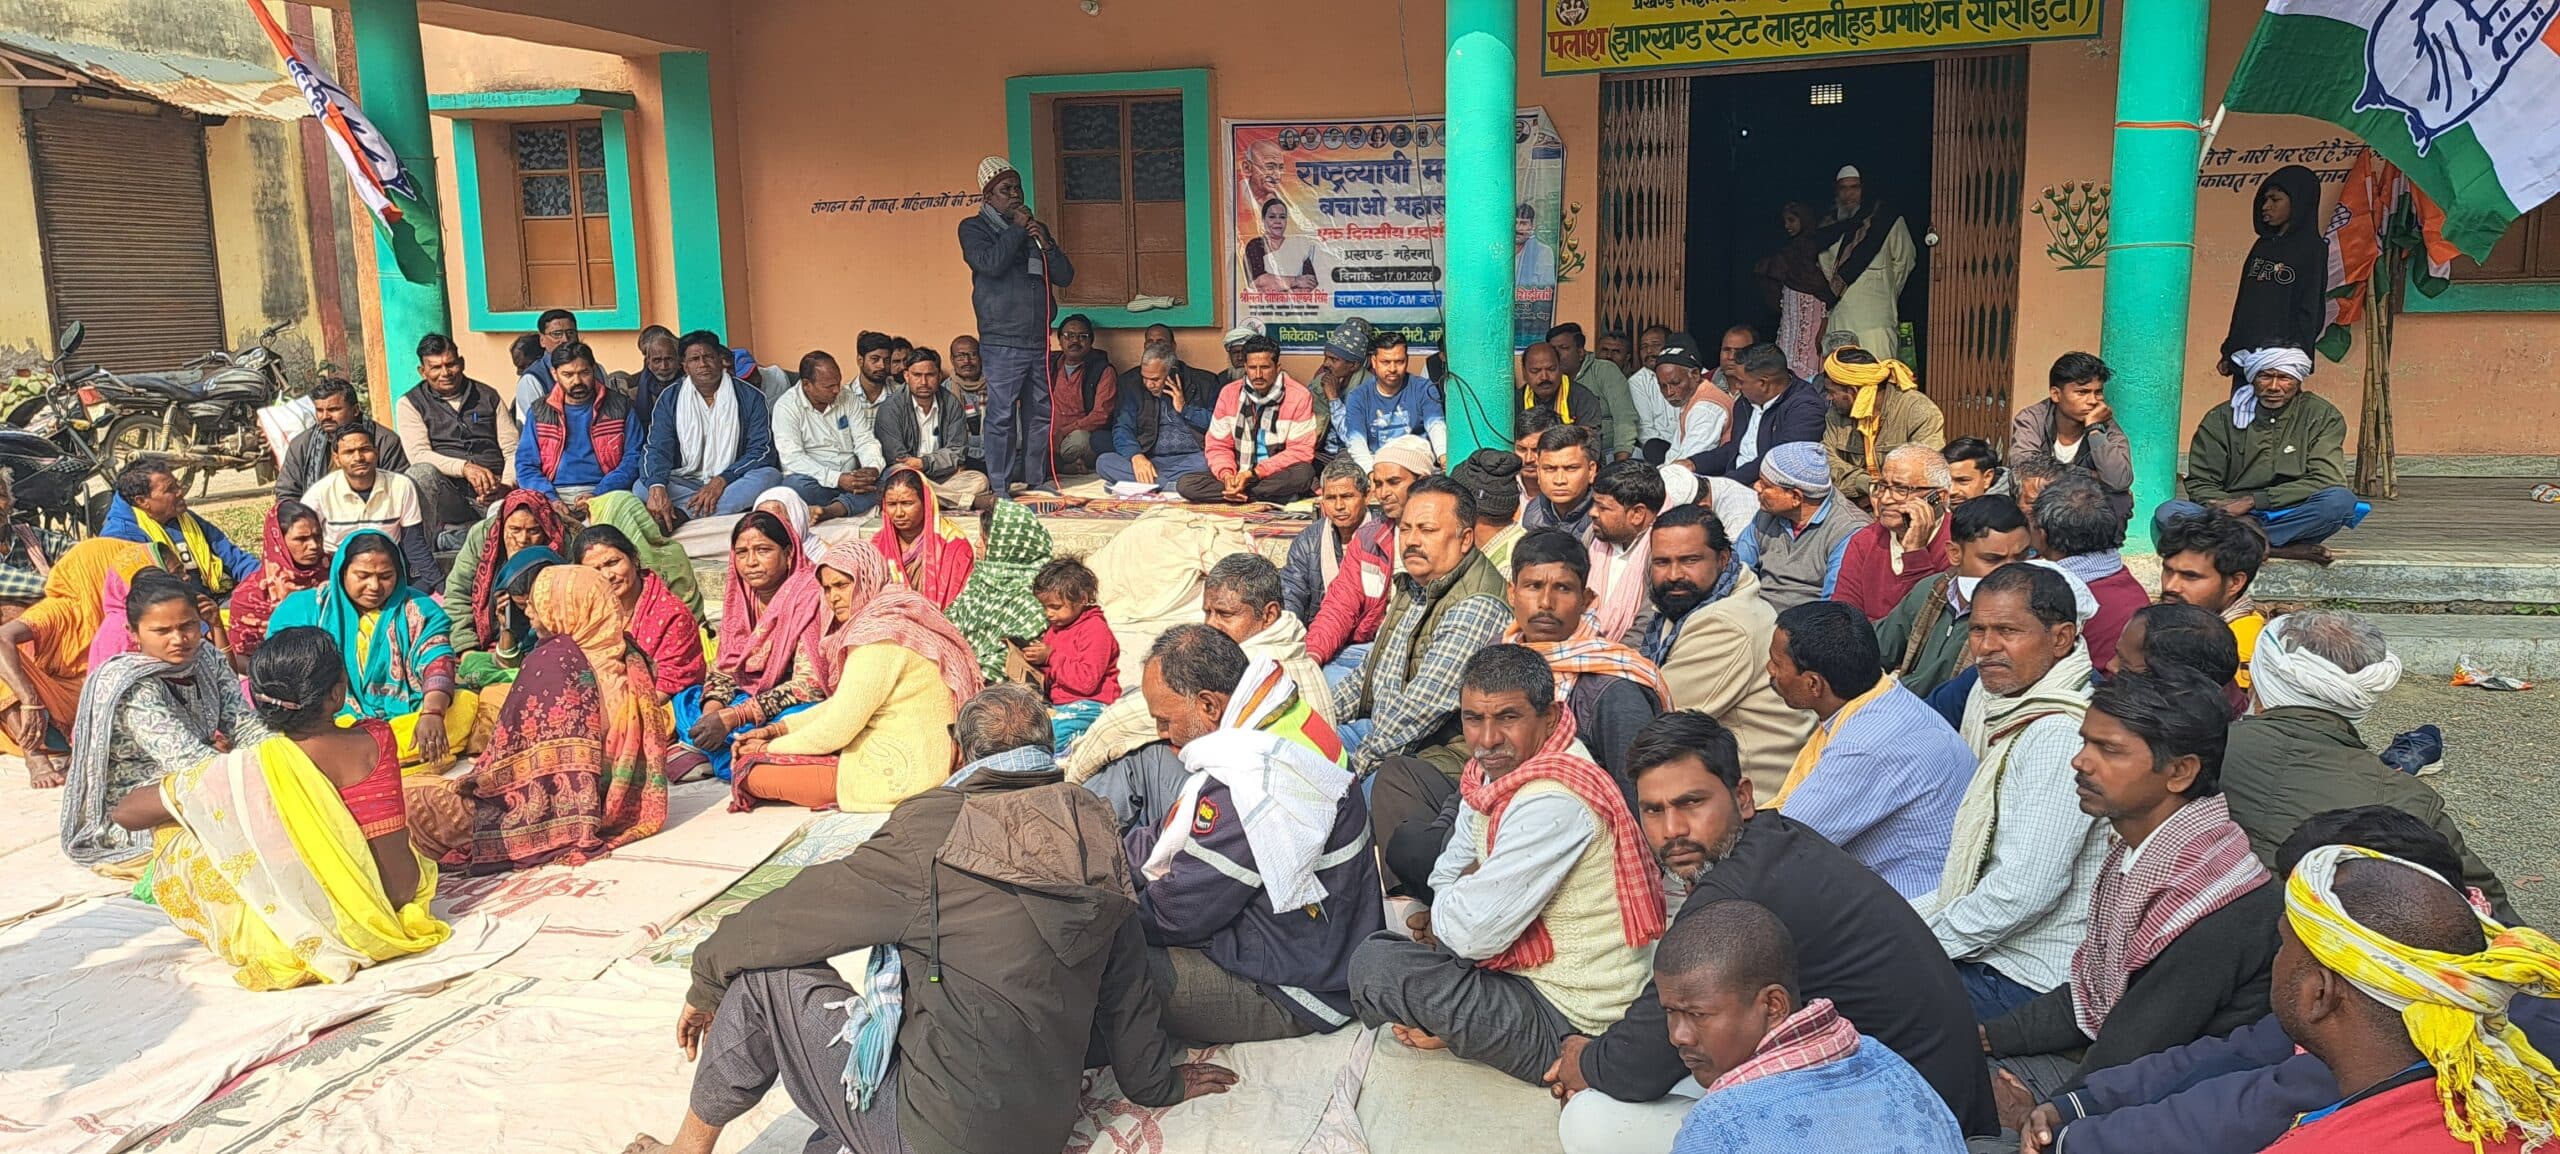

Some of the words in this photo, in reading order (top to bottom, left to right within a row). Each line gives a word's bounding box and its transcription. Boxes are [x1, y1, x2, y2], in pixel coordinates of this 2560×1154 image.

[1705, 9, 1762, 53] स्टेट
[2238, 143, 2275, 165] नारी
[2297, 140, 2327, 163] रही
[1295, 150, 1412, 193] राष्ट्रव्यापी
[812, 199, 848, 213] संगठन
[849, 195, 866, 212] की
[901, 191, 951, 211] महिलाओं
[950, 190, 967, 207] की
[1319, 189, 1388, 217] बचाओ
[1317, 226, 1344, 243] एक
[1346, 222, 1404, 241] दिवसीय
[1383, 271, 1433, 282] 17.01.2026
[1371, 293, 1396, 306] 11:00
[1398, 294, 1416, 306] AM
